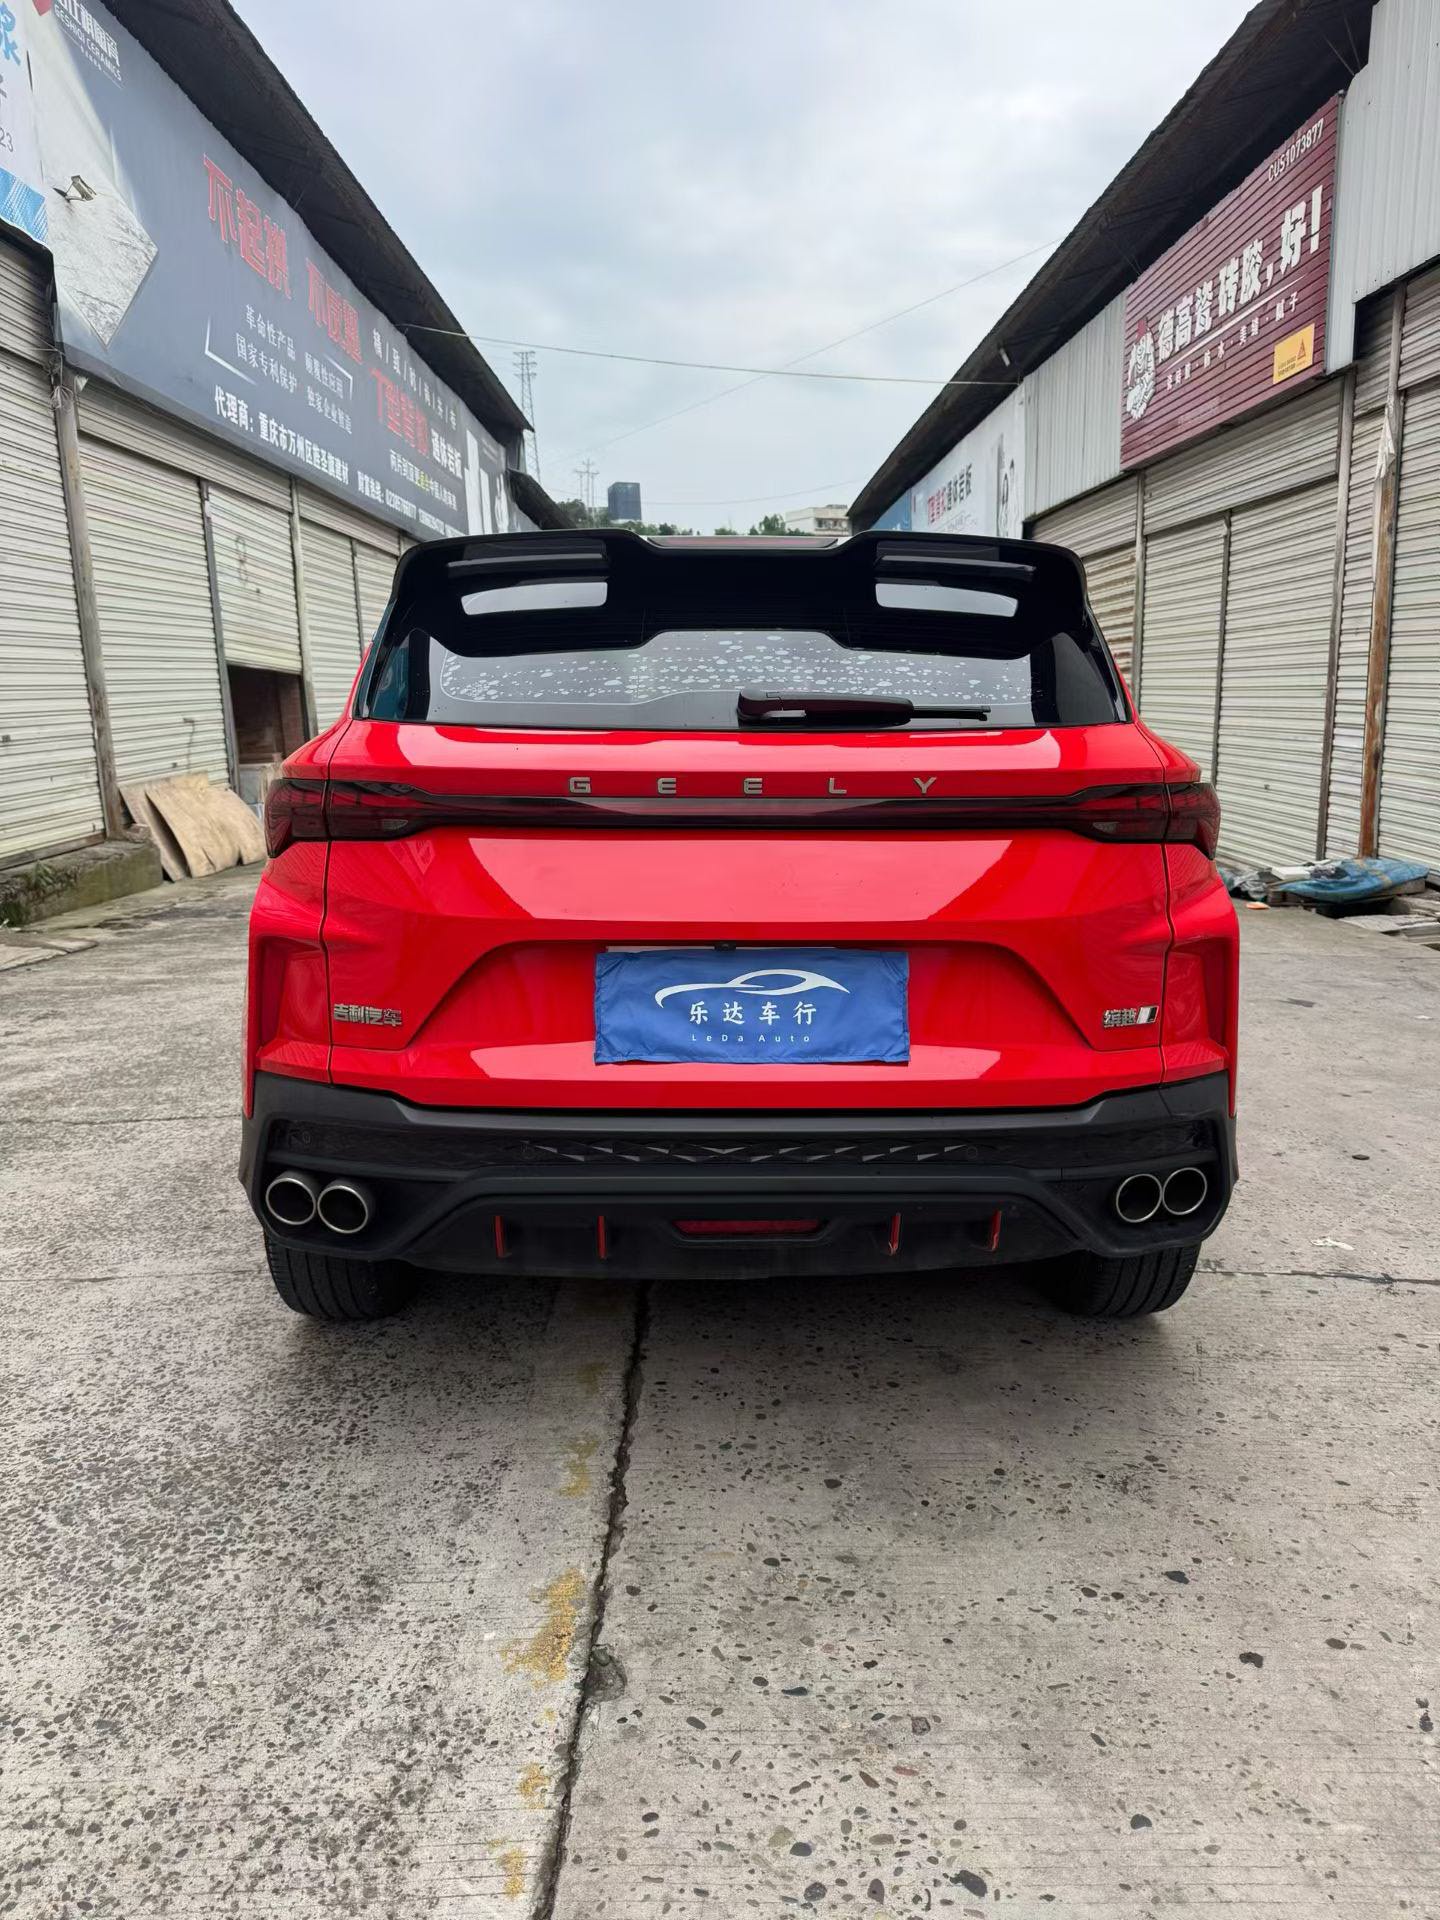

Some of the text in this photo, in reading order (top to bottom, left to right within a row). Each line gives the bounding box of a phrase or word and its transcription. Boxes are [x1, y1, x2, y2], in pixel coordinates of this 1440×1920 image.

[1268, 118, 1324, 182] CUS1073877
[246, 304, 296, 360] 革命性产品
[236, 332, 297, 394] 国家专利保护
[214, 384, 253, 432] 代理商：
[569, 777, 937, 795] GEELY
[333, 1003, 402, 1027] 吉利汽车
[689, 1001, 817, 1026] 乐达车行
[758, 1033, 810, 1042] Auto
